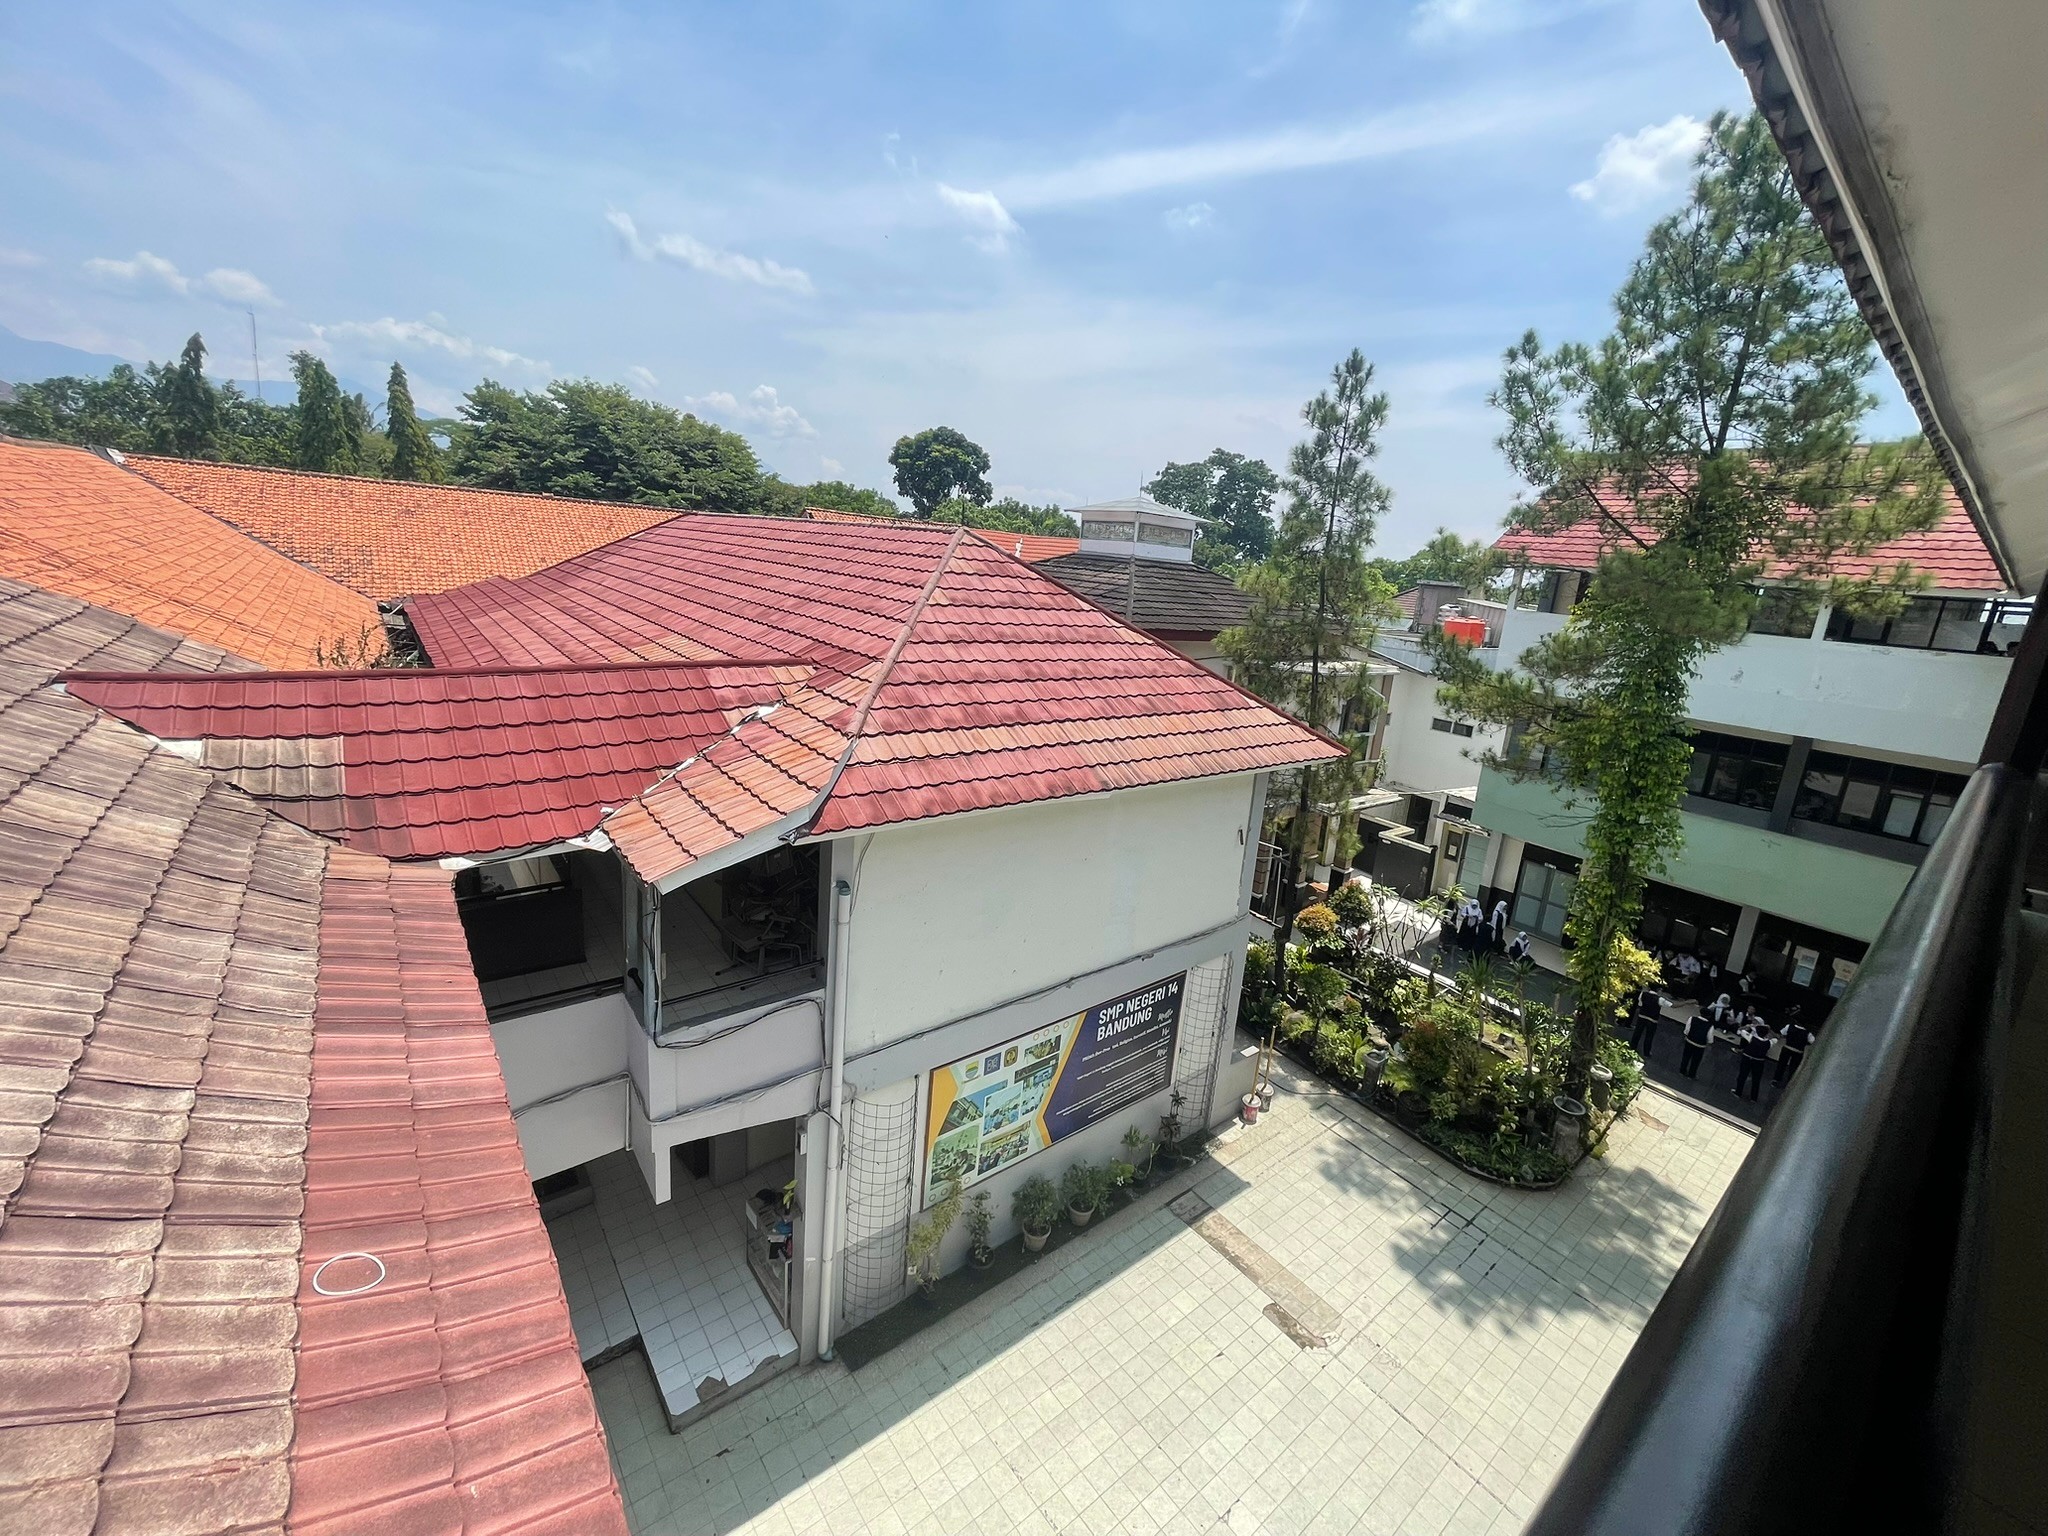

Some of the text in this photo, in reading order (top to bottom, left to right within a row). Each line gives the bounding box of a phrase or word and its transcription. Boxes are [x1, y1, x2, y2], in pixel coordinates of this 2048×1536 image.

[1098, 981, 1179, 1025] SMP NEGERI 14
[1096, 1006, 1153, 1042] BANDUNG
